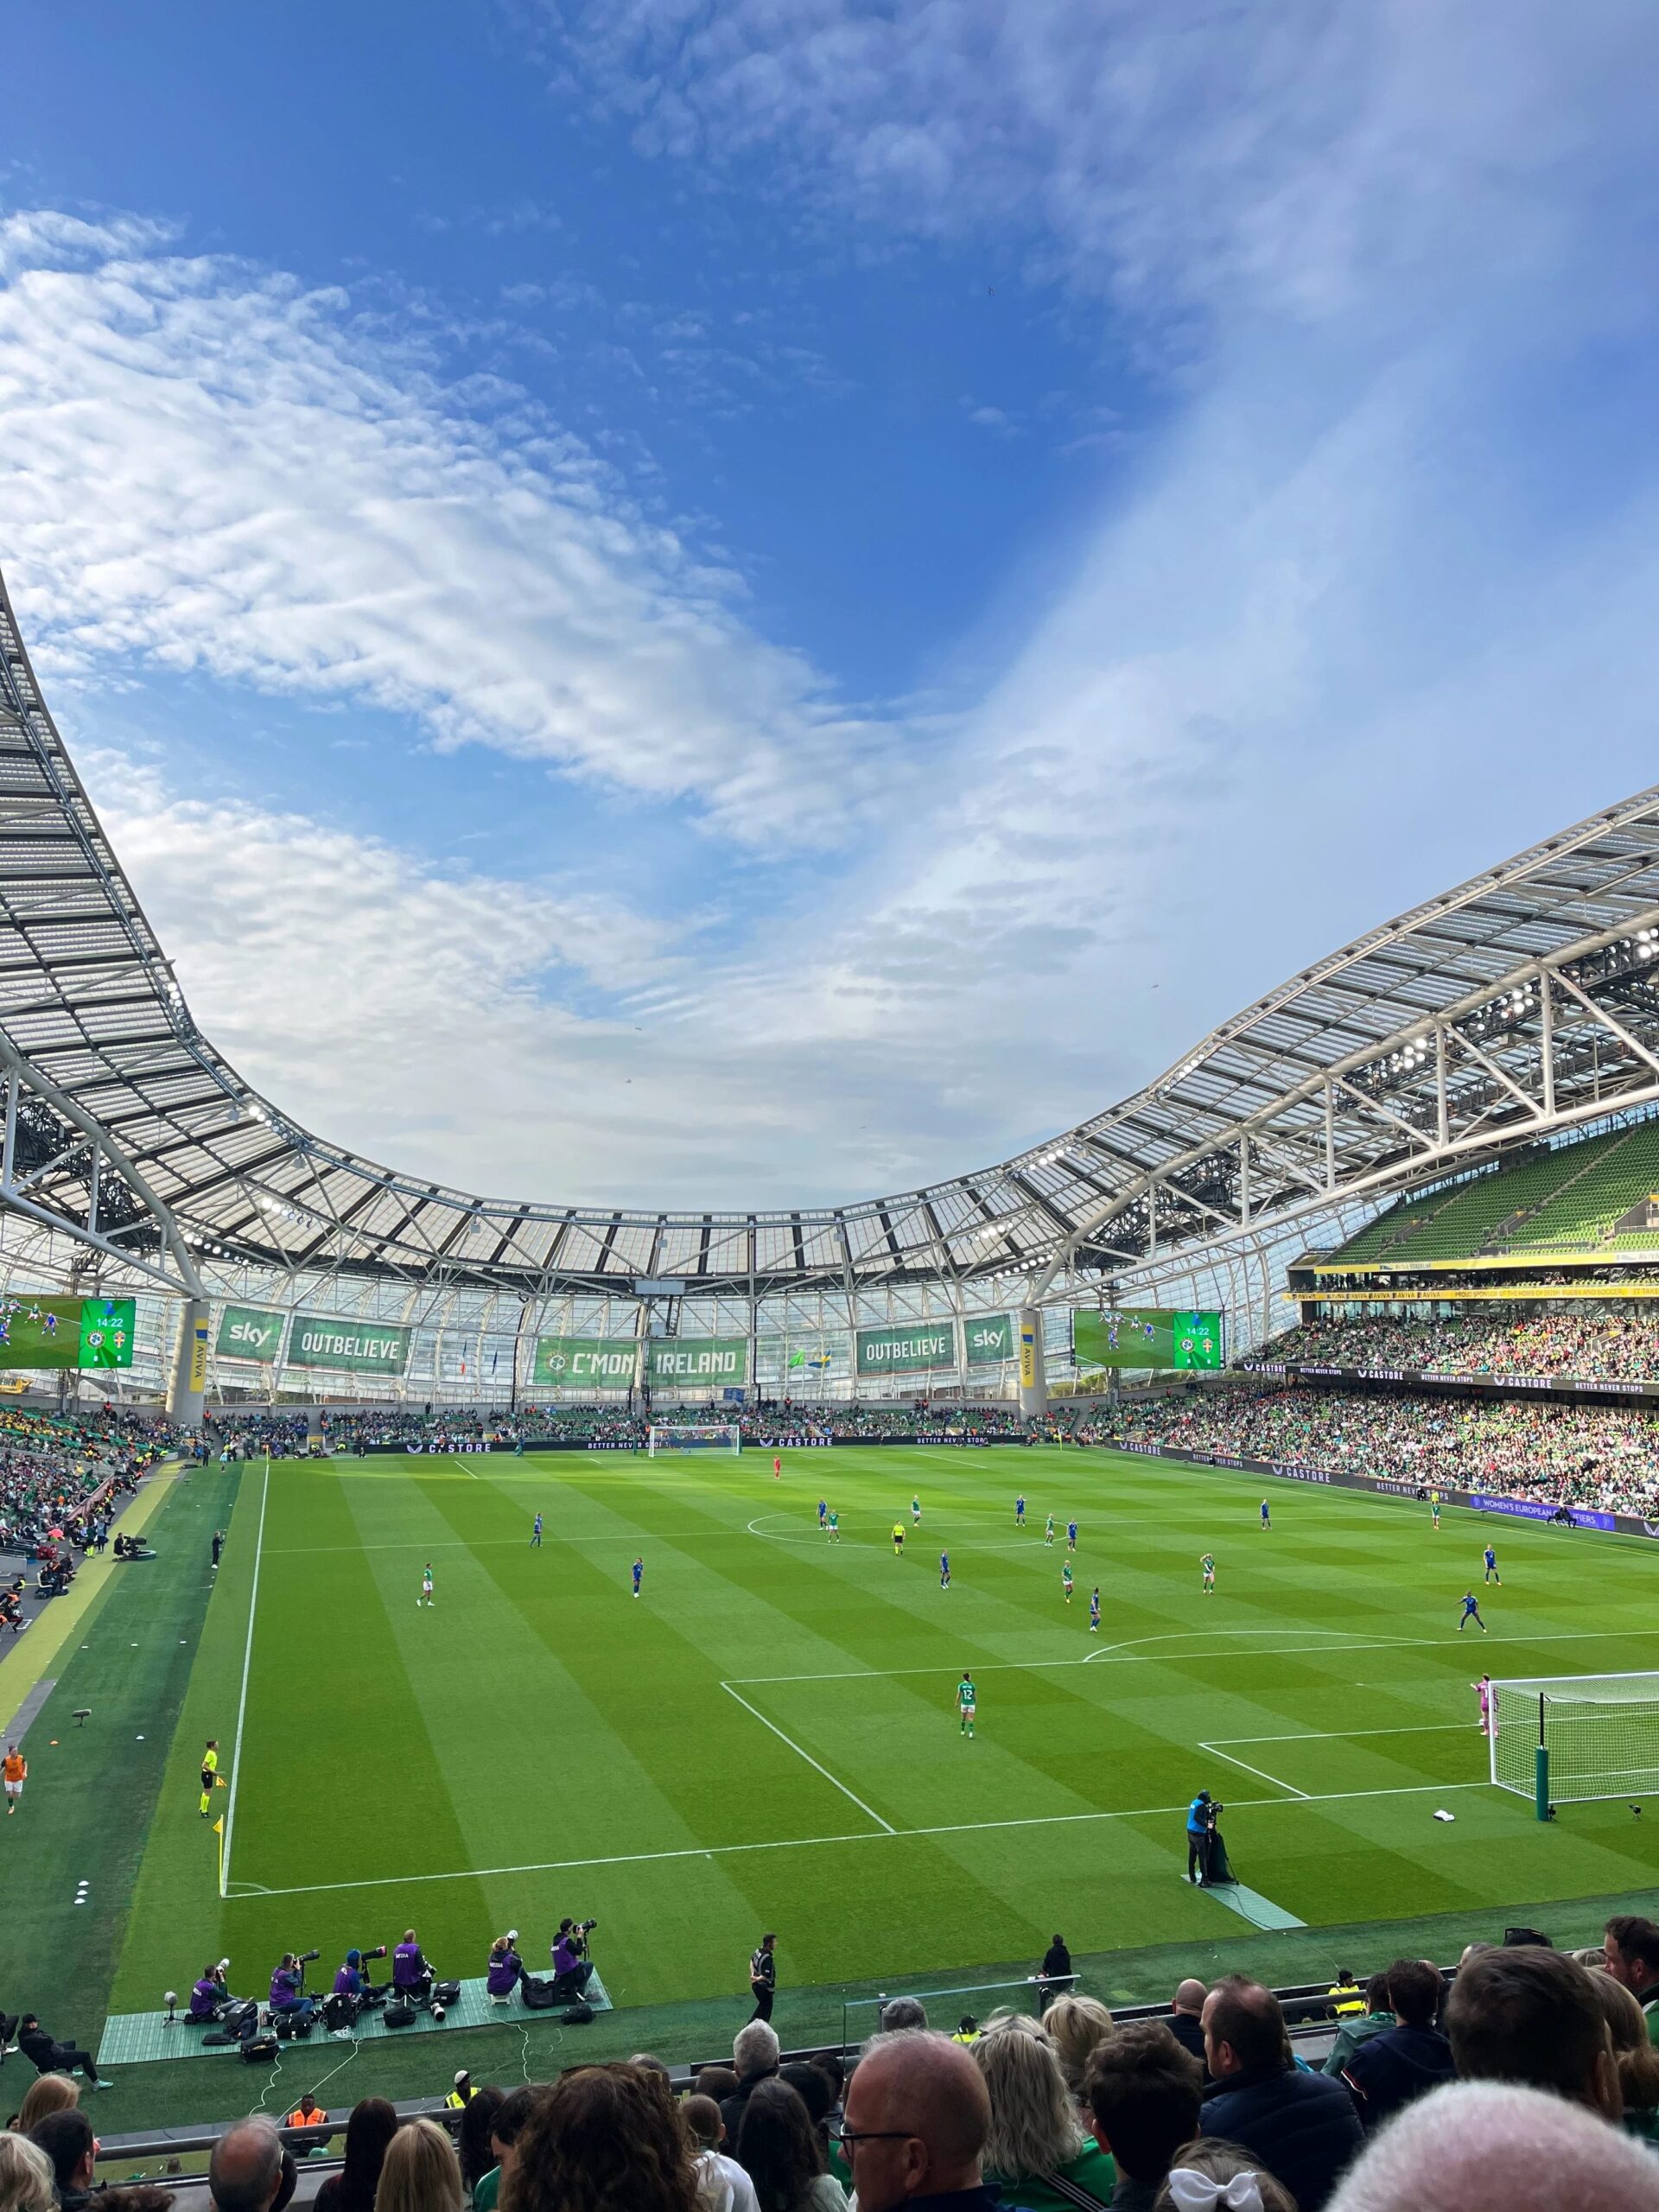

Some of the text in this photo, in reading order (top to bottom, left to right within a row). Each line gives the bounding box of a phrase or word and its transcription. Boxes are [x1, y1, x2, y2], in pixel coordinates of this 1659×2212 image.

[97, 1318, 124, 1327] 14:22
[229, 1322, 272, 1347] sky
[973, 1328, 1004, 1348] sky
[1186, 1327, 1210, 1336] 14:22
[301, 1332, 400, 1360] OUTBELIEVE
[866, 1337, 946, 1361] OUTBELIEVE
[194, 1345, 205, 1378] AVIVA
[572, 1353, 635, 1374] C'MON
[656, 1351, 736, 1374] IRELAND
[1255, 1363, 1287, 1373] CASTORE
[1369, 1370, 1404, 1381] CASTORE
[1508, 1377, 1552, 1389] CASTORE
[1575, 1382, 1643, 1393] BETTER NEVER STOPS
[429, 1443, 492, 1453] CSTORE
[779, 1437, 833, 1446] CASTORE
[1129, 1442, 1161, 1456] CASTORE
[1192, 1453, 1210, 1462] BETTER
[1227, 1459, 1243, 1468] STOPS
[1287, 1466, 1331, 1484] CASTORE
[1376, 1482, 1402, 1492] BETTER
[1483, 1498, 1514, 1512] WOMEN'S
[1515, 1504, 1553, 1516] EUROPEAN
[963, 1689, 973, 1700] 12
